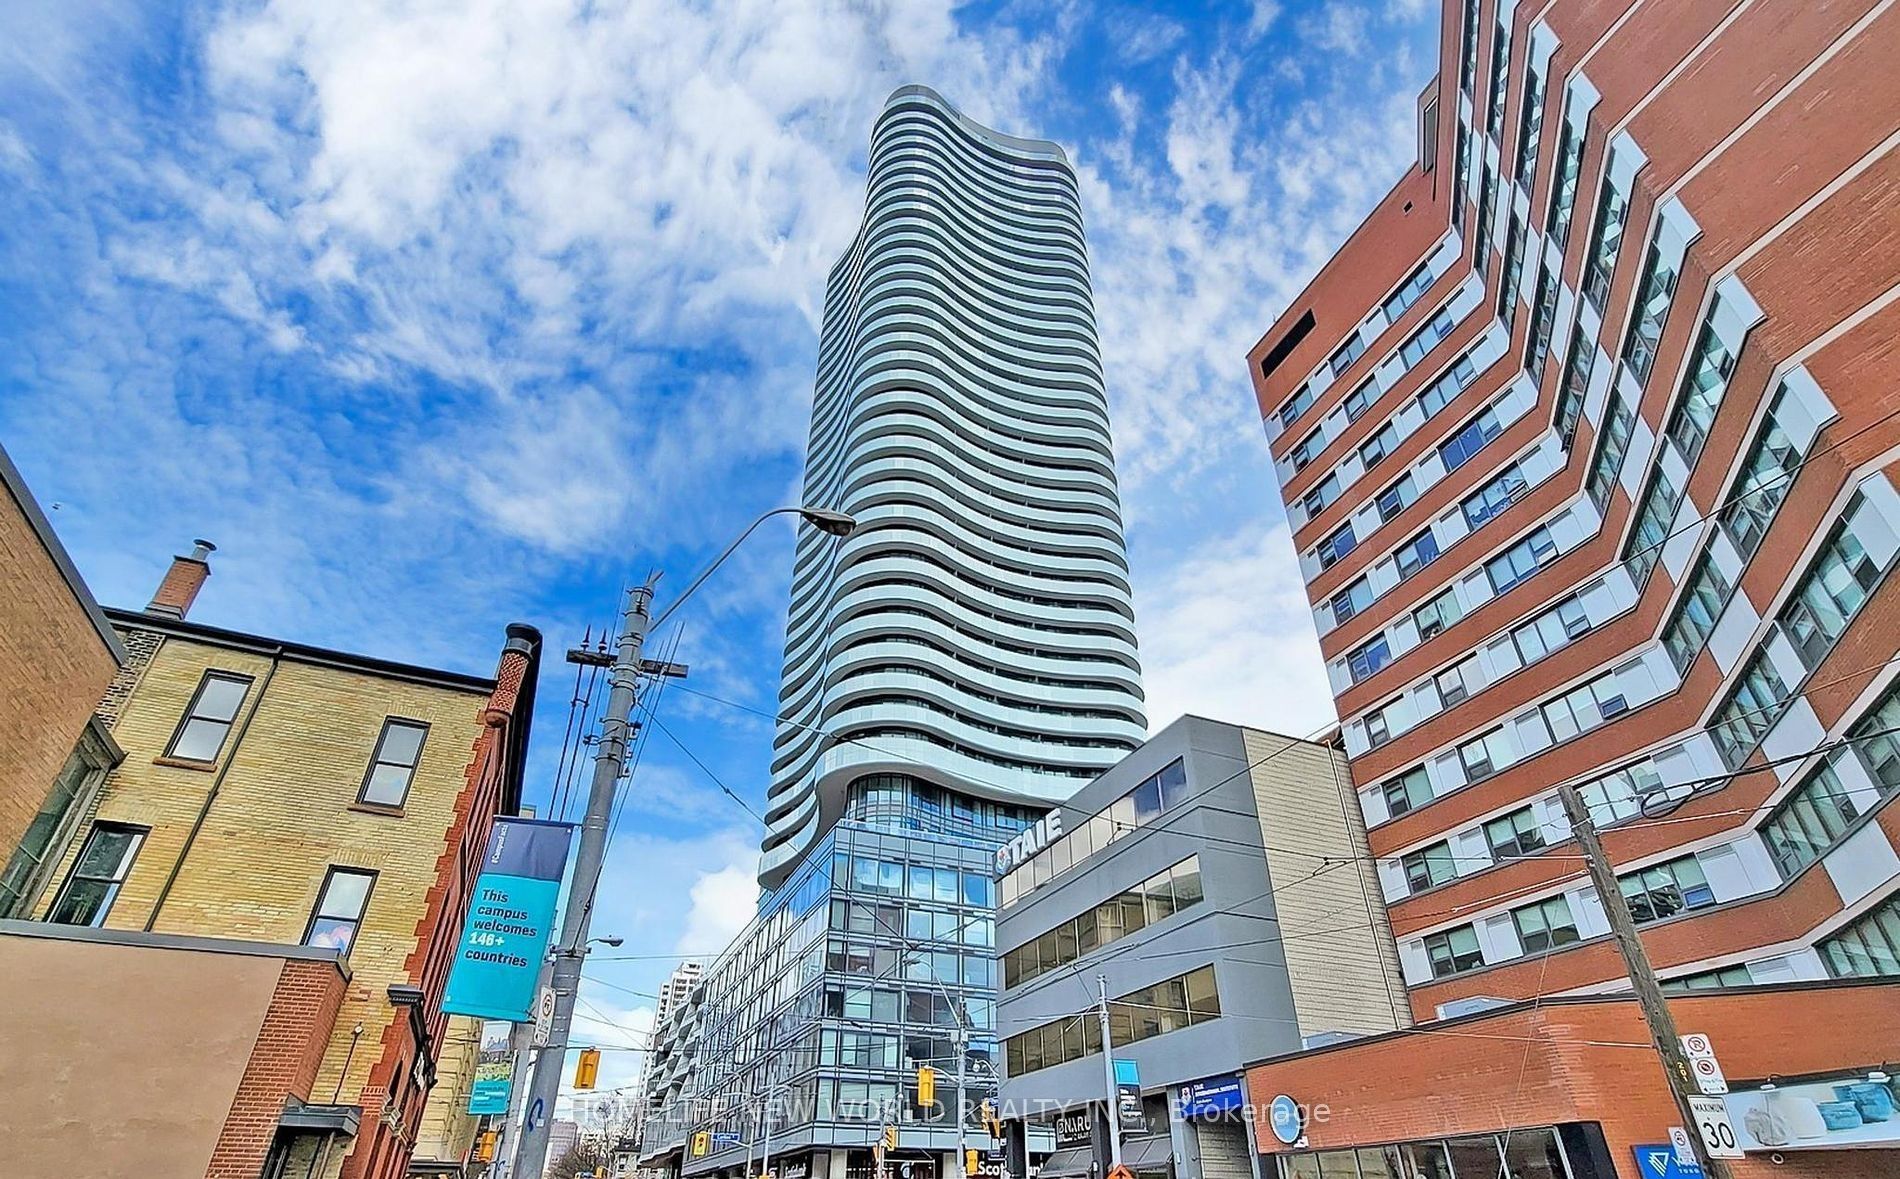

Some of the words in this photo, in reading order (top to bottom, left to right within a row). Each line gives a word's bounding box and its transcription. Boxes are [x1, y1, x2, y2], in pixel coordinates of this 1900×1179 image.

[1008, 807, 1062, 865] TAIE
[482, 889, 508, 903] This
[478, 905, 528, 920] campus
[473, 918, 537, 937] welcomes
[465, 949, 527, 967] countries
[1703, 1122, 1735, 1149] 30
